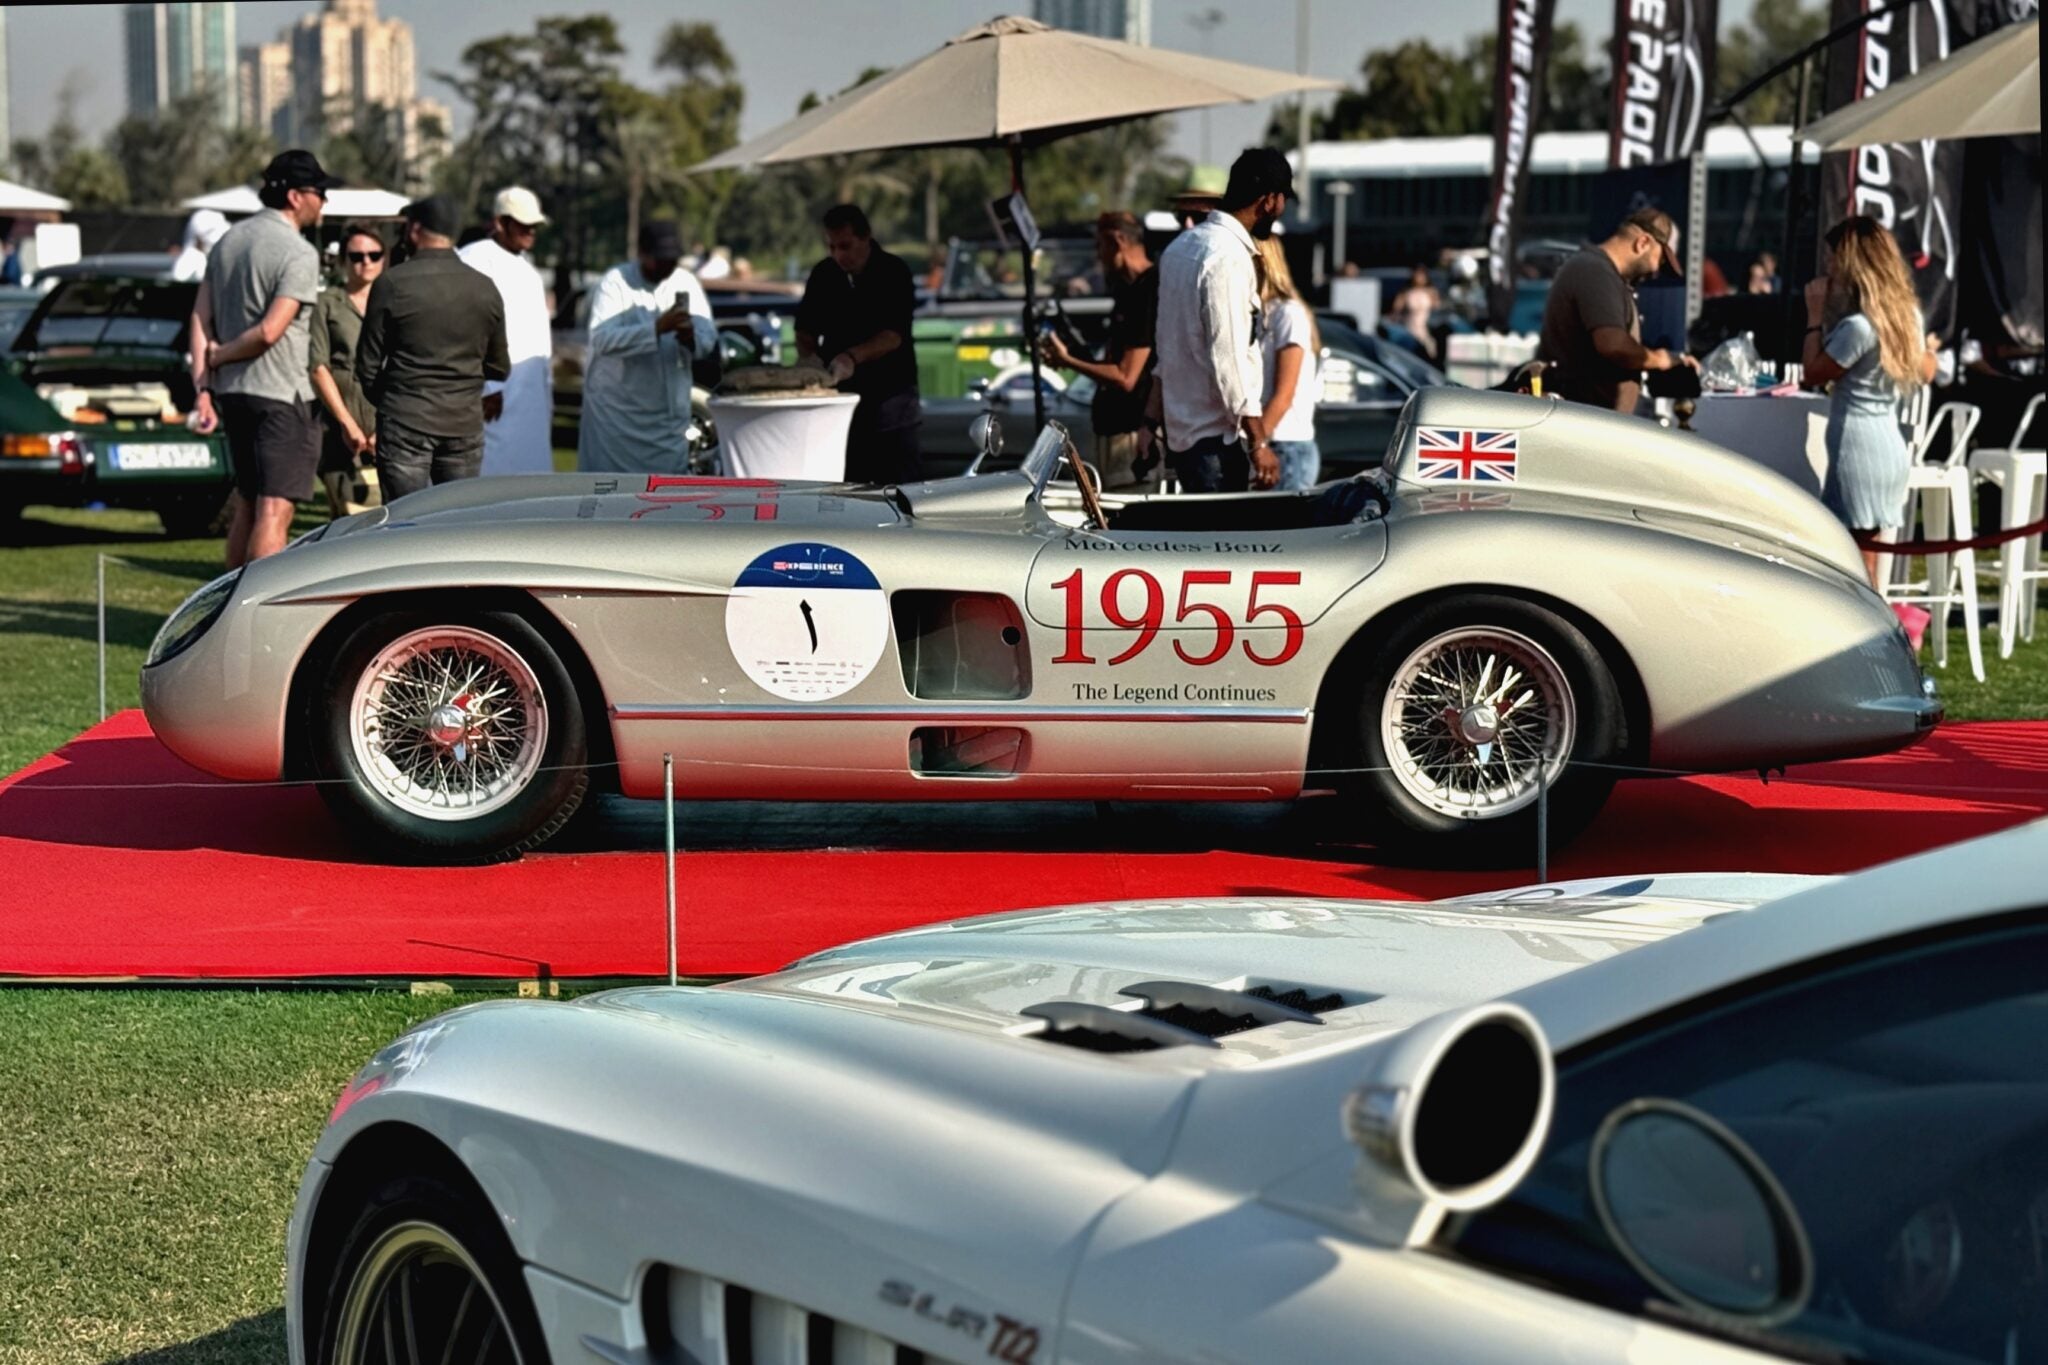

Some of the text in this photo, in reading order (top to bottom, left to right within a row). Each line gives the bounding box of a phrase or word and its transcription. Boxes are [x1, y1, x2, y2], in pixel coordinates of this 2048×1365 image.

[1064, 538, 1284, 553] Mercedes-Benz
[1051, 567, 1304, 667] 1955
[1072, 683, 1276, 703] The Legend Continues
